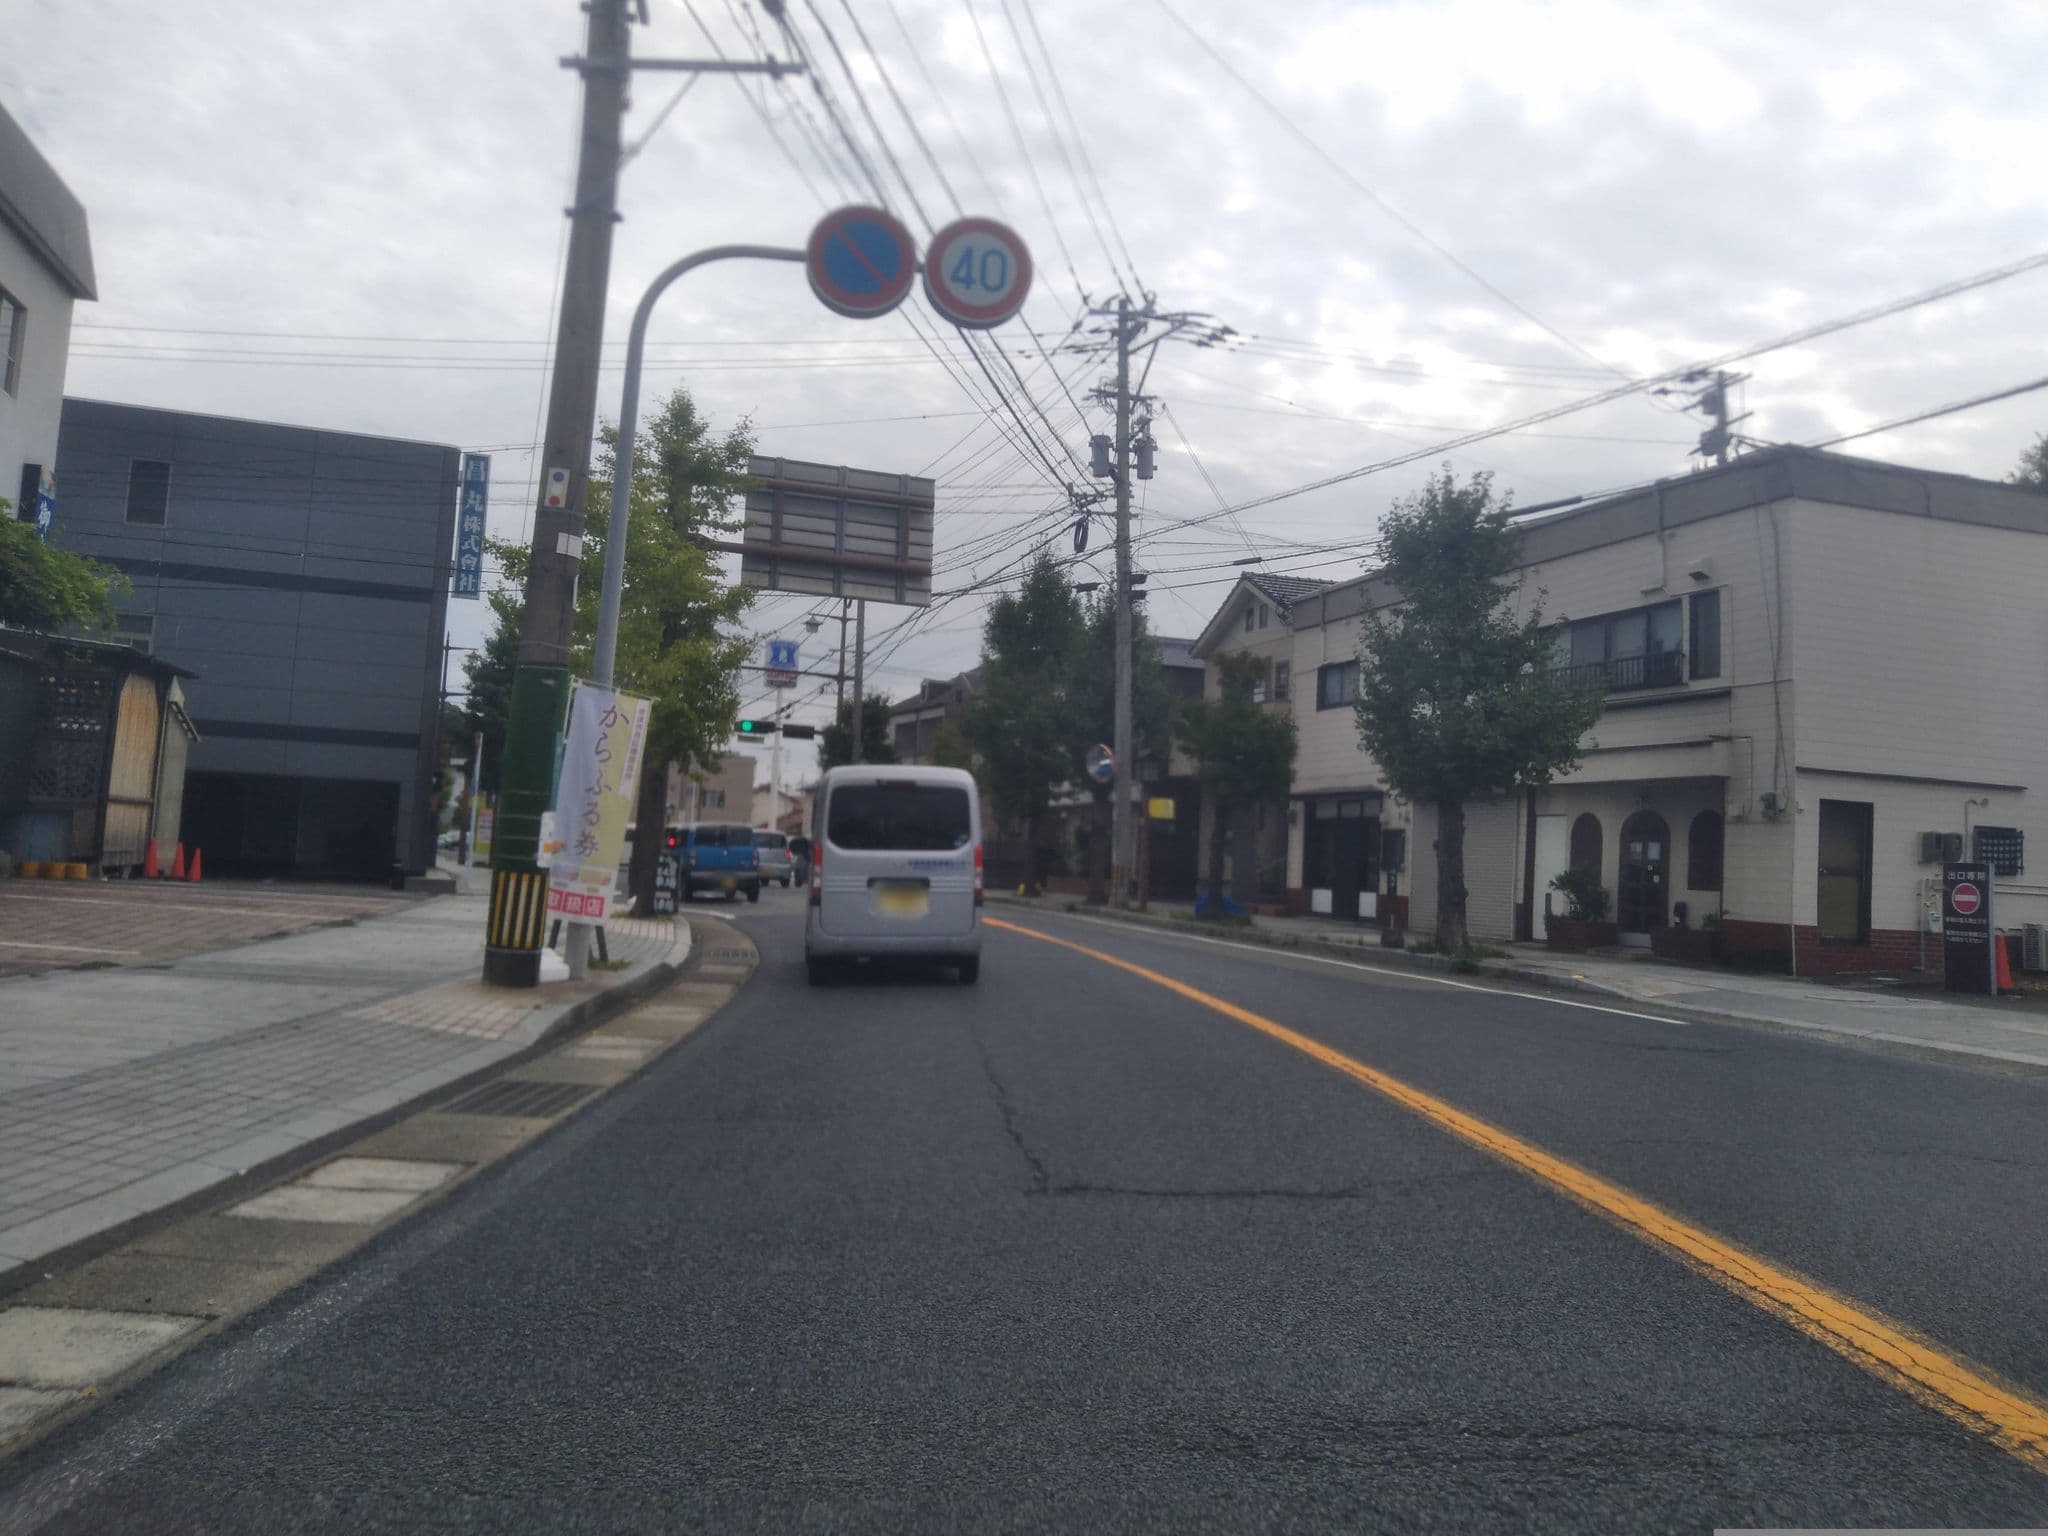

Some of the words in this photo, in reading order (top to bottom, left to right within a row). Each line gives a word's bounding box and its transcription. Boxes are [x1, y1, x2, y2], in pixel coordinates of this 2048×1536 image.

[950, 246, 1007, 292] 40
[1947, 871, 1986, 881] 出口専用
